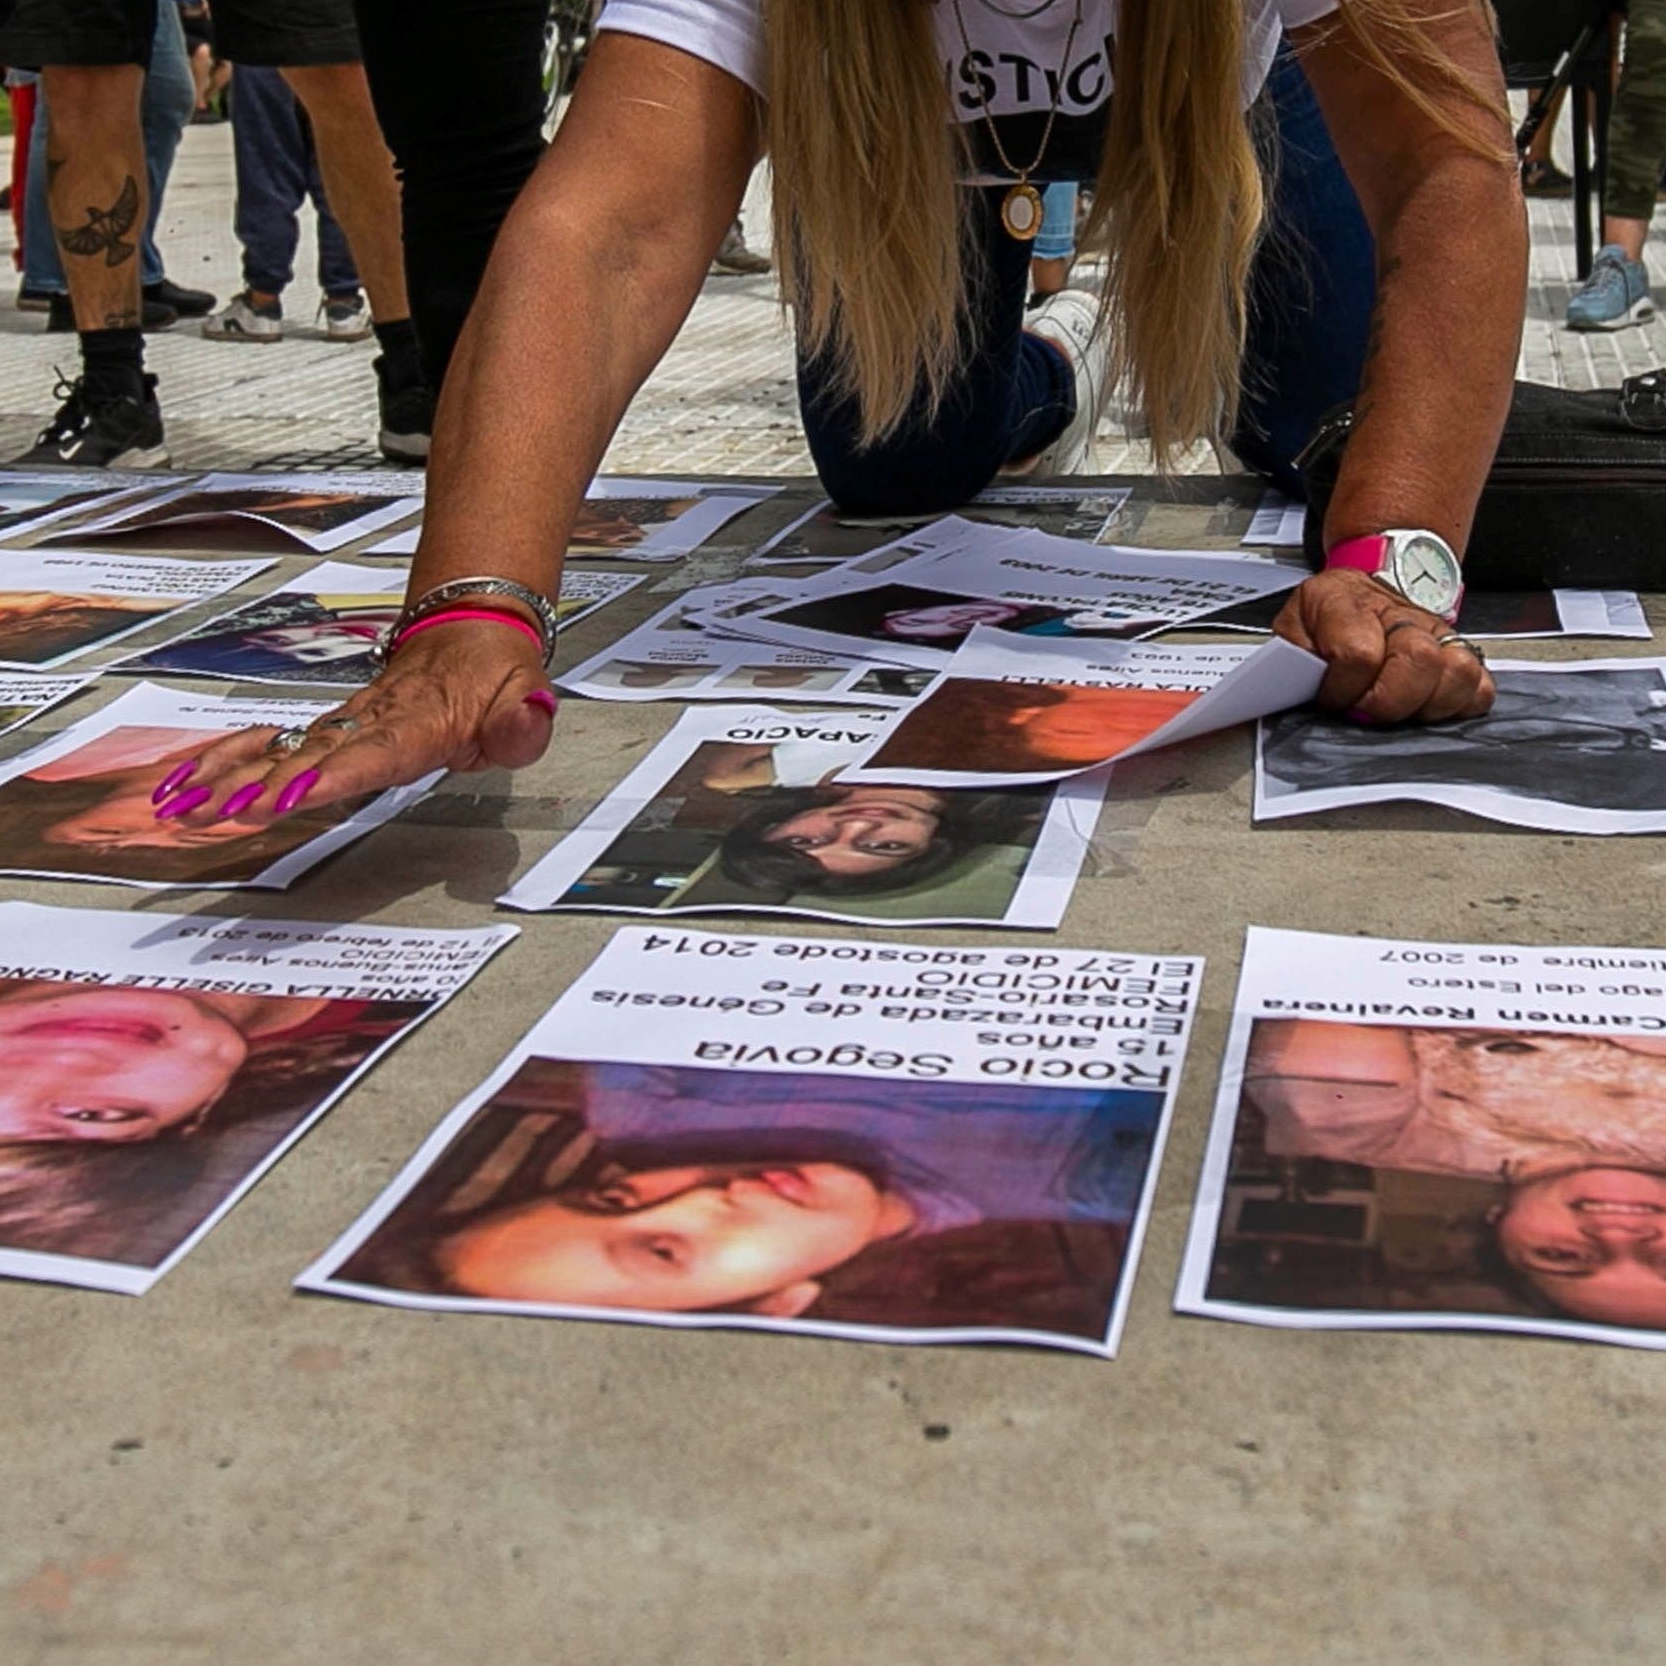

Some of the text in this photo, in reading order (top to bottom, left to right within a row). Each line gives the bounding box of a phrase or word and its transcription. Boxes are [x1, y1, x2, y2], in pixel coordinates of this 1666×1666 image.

[955, 34, 1115, 109] STIC
[727, 726, 879, 744] APACIO
[254, 931, 289, 942] de
[294, 933, 393, 948] febrero
[401, 939, 434, 949] de
[438, 939, 472, 950] 12
[209, 953, 473, 973] anus-Buenos Aires
[340, 949, 485, 962] EMICIDIO
[642, 934, 1196, 977] El 27 de agostode 2014
[1378, 950, 1464, 965] 2007
[1478, 954, 1517, 967] de
[122, 974, 273, 994] GISELLE
[360, 974, 430, 985] años
[915, 970, 1190, 995] FEMICIDIO
[1407, 977, 1521, 994] Estero
[759, 980, 1190, 1014] Rosario-Santa Fe
[1533, 982, 1587, 995] del
[590, 989, 1186, 1035] Embarazada de Génesis
[976, 1031, 1175, 1056] 15 años
[695, 1040, 1173, 1088] Rocio Segovia
